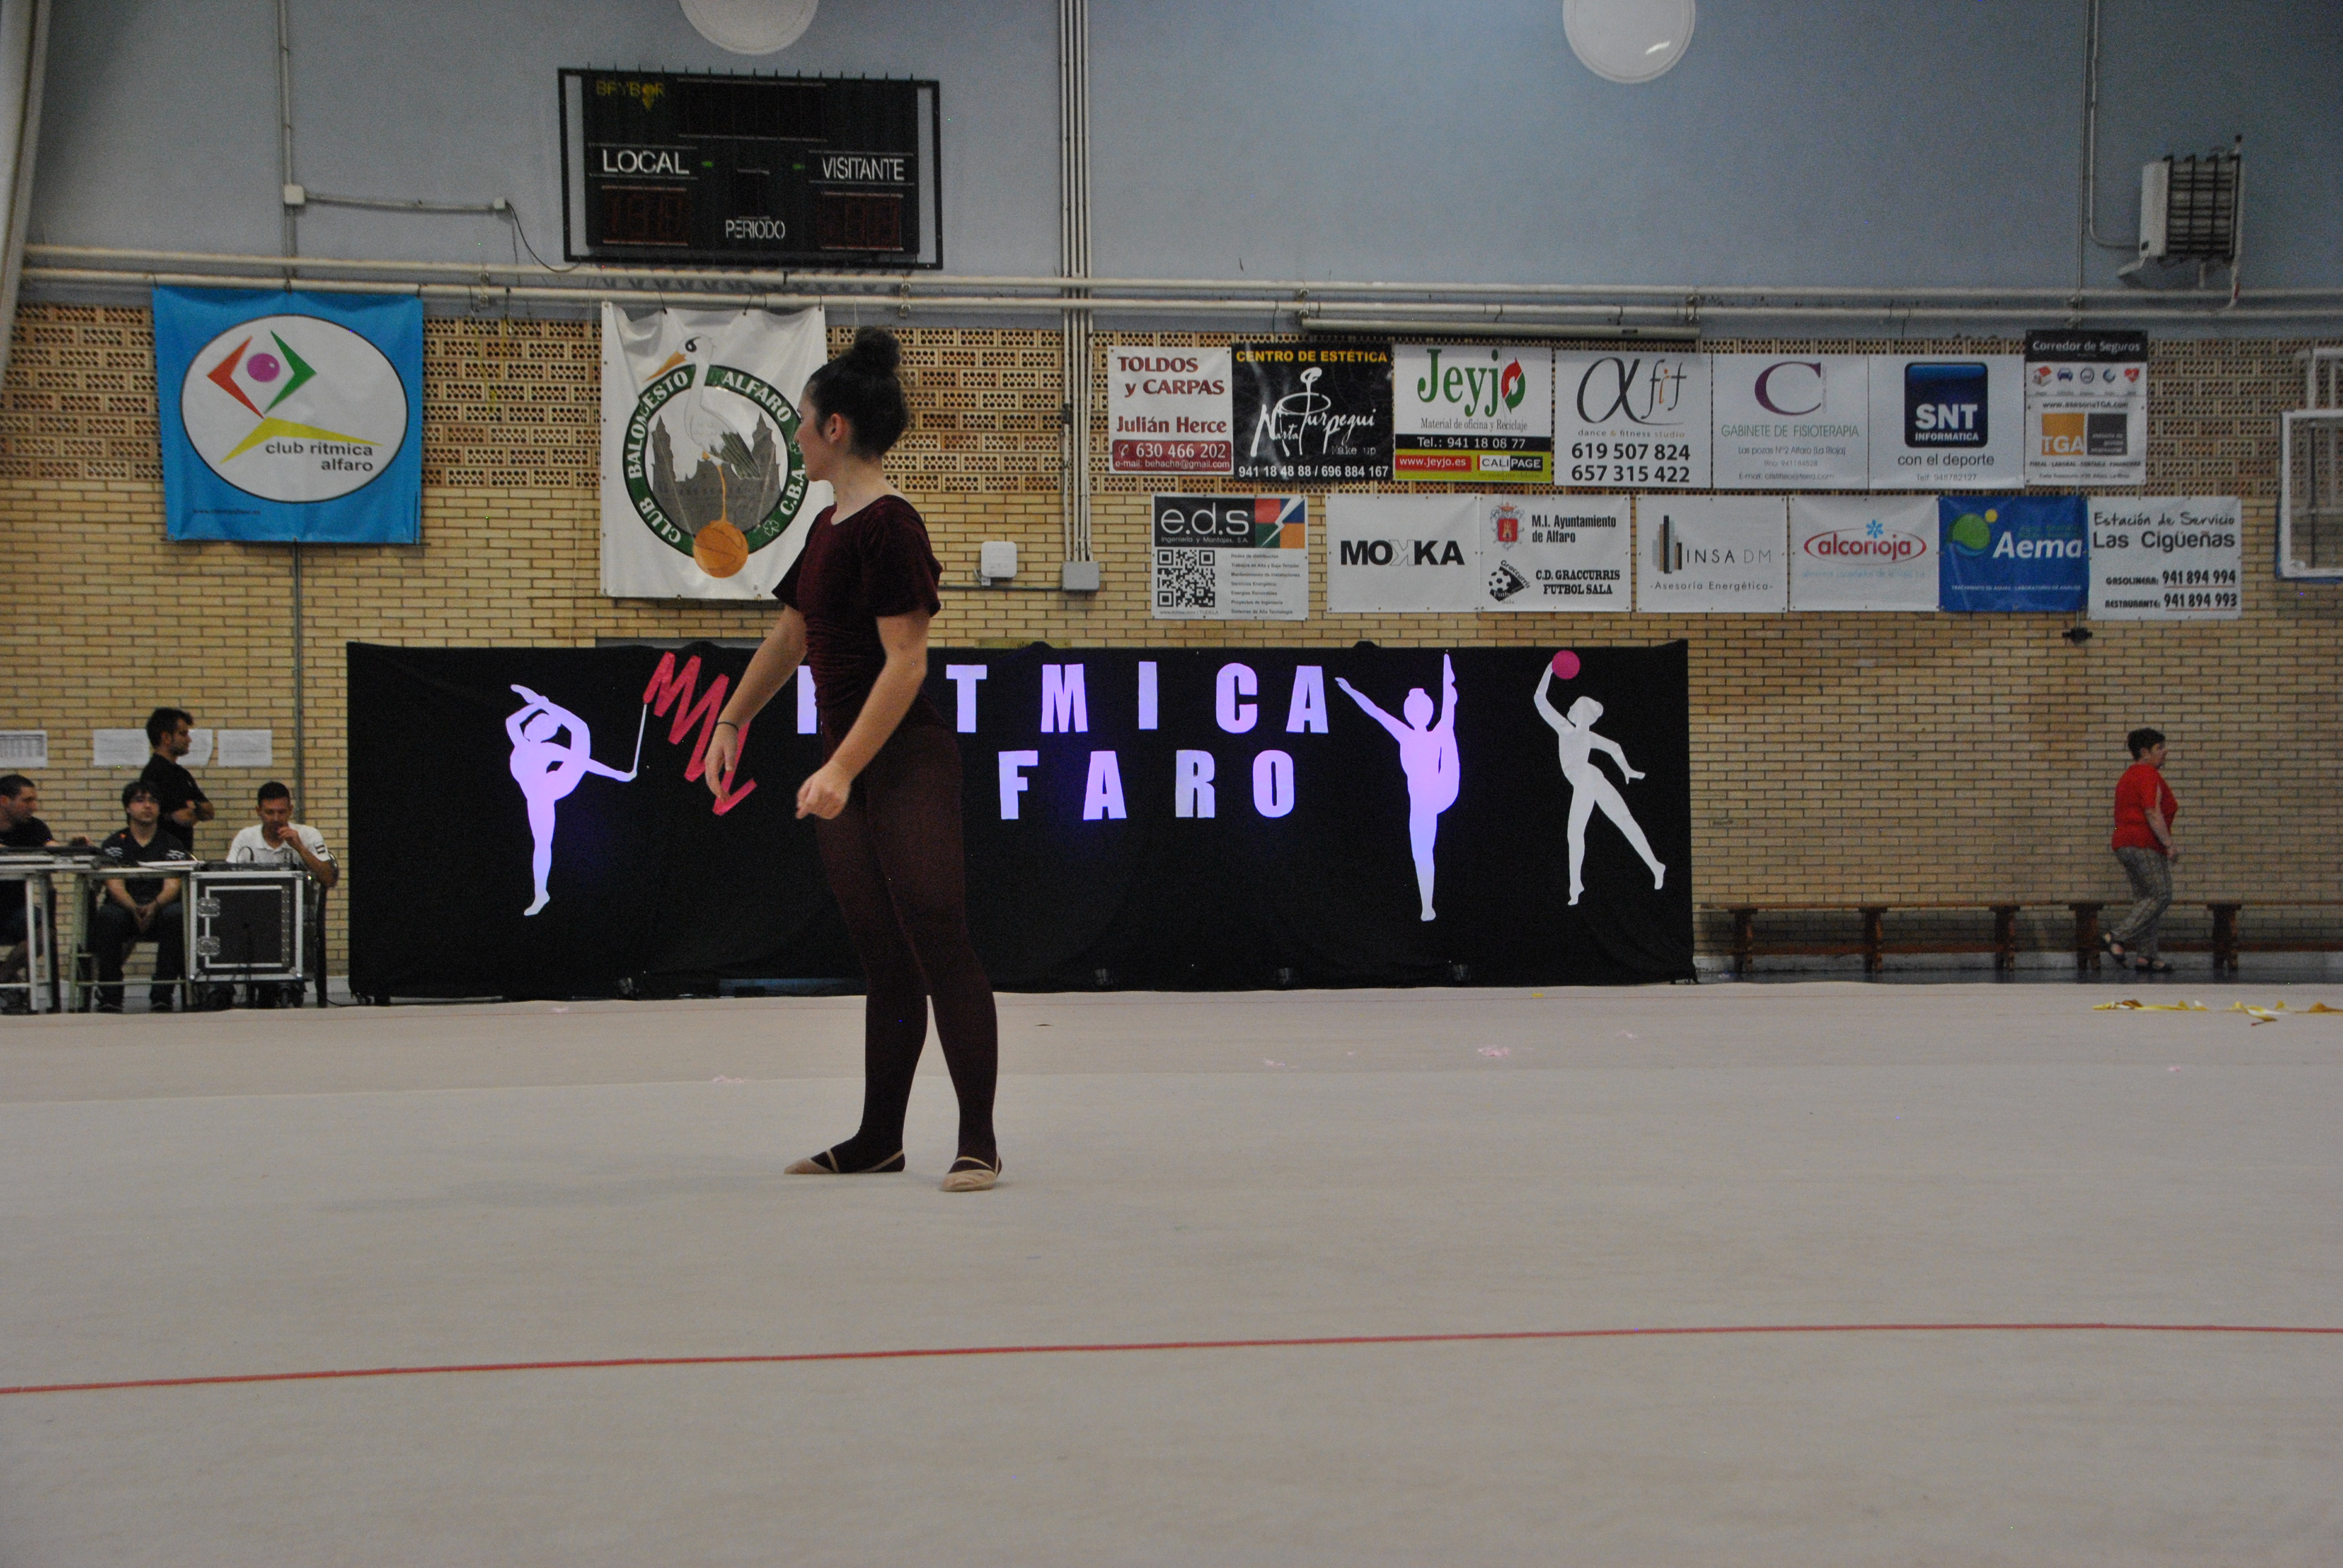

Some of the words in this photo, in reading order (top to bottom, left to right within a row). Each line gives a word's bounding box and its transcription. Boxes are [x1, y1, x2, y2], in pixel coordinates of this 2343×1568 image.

[603, 149, 689, 175] LOCAL
[822, 157, 904, 180] VISITANTE
[726, 220, 785, 239] PERIODO
[1236, 351, 1294, 362] CENTRO
[1298, 351, 1316, 362] DE
[1320, 348, 1388, 362] ESTÉTICA
[2033, 341, 2081, 351] Corredor
[2083, 341, 2096, 351] de
[2100, 341, 2140, 354] Seguros
[1117, 356, 1198, 373] TOLDOS
[1125, 383, 1136, 397] y
[1142, 379, 1225, 394] CARPAS
[1915, 403, 1978, 430] SNT
[1116, 416, 1169, 433] Julián
[1176, 416, 1227, 433] Herce
[1421, 418, 1452, 430] Material
[1454, 419, 1463, 430] de
[1464, 419, 1488, 430] oficina
[1490, 421, 1495, 431] y
[1496, 419, 1527, 432] Reciclaje
[1721, 425, 1770, 437] GABINETE
[1774, 425, 1788, 437] DE
[1794, 425, 1859, 437] FISIOTERAPIA
[1417, 437, 1442, 447] Tel.:
[1447, 437, 1469, 448] 941
[1475, 439, 1488, 448] 18
[1493, 438, 1506, 448] 08
[1513, 439, 1525, 448] 77
[1915, 432, 1979, 441] INFORMATICA
[2042, 435, 2084, 453] TGA
[266, 442, 303, 454] club
[1136, 443, 1162, 457] 630
[1168, 443, 1194, 458] 466
[1200, 443, 1225, 458] 202
[1571, 442, 1608, 459] 619
[1613, 443, 1648, 459] 507
[1654, 443, 1690, 460] 824
[638, 497, 681, 543] CLUB
[723, 371, 791, 422] ALFARO
[1400, 457, 1466, 468] www.jeyjo.es
[1898, 455, 1922, 465] con
[1927, 454, 1938, 465] el
[1942, 454, 1994, 468] deporte
[321, 458, 373, 472] alfaro
[1239, 465, 1258, 477] 941
[1263, 466, 1277, 477] 18
[1280, 466, 1294, 477] 48
[1298, 466, 1311, 478] 88
[1322, 466, 1342, 477] 696
[1345, 466, 1365, 477] 884
[1369, 466, 1388, 477] 167
[1571, 465, 1608, 481] 657
[1613, 465, 1649, 482] 315
[1654, 466, 1689, 482] 422
[1161, 502, 1249, 535] e.d.s
[1532, 515, 1550, 528] M.I.
[1554, 515, 1616, 529] Ayuntamiento
[2094, 511, 2151, 527] Estación
[2158, 513, 2174, 526] de
[2180, 512, 2235, 526] Servicio
[1532, 531, 1542, 543] de
[1547, 530, 1576, 543] Alfaro
[2093, 532, 2129, 549] Las
[2141, 531, 2235, 553] Cigüeñas
[1818, 532, 1911, 561] alcorioja
[1993, 531, 2083, 558] Aema
[1536, 570, 1553, 580] C.D.
[1555, 570, 1620, 580] GRACCURRIS
[2162, 570, 2183, 584] 941
[2187, 570, 2209, 584] 894
[2213, 570, 2236, 584] 994
[1543, 584, 1584, 594] FUTBOL
[1586, 584, 1613, 594] SALA
[2164, 593, 2184, 608] 941
[2188, 593, 2211, 608] 894
[2215, 593, 2237, 607] 993
